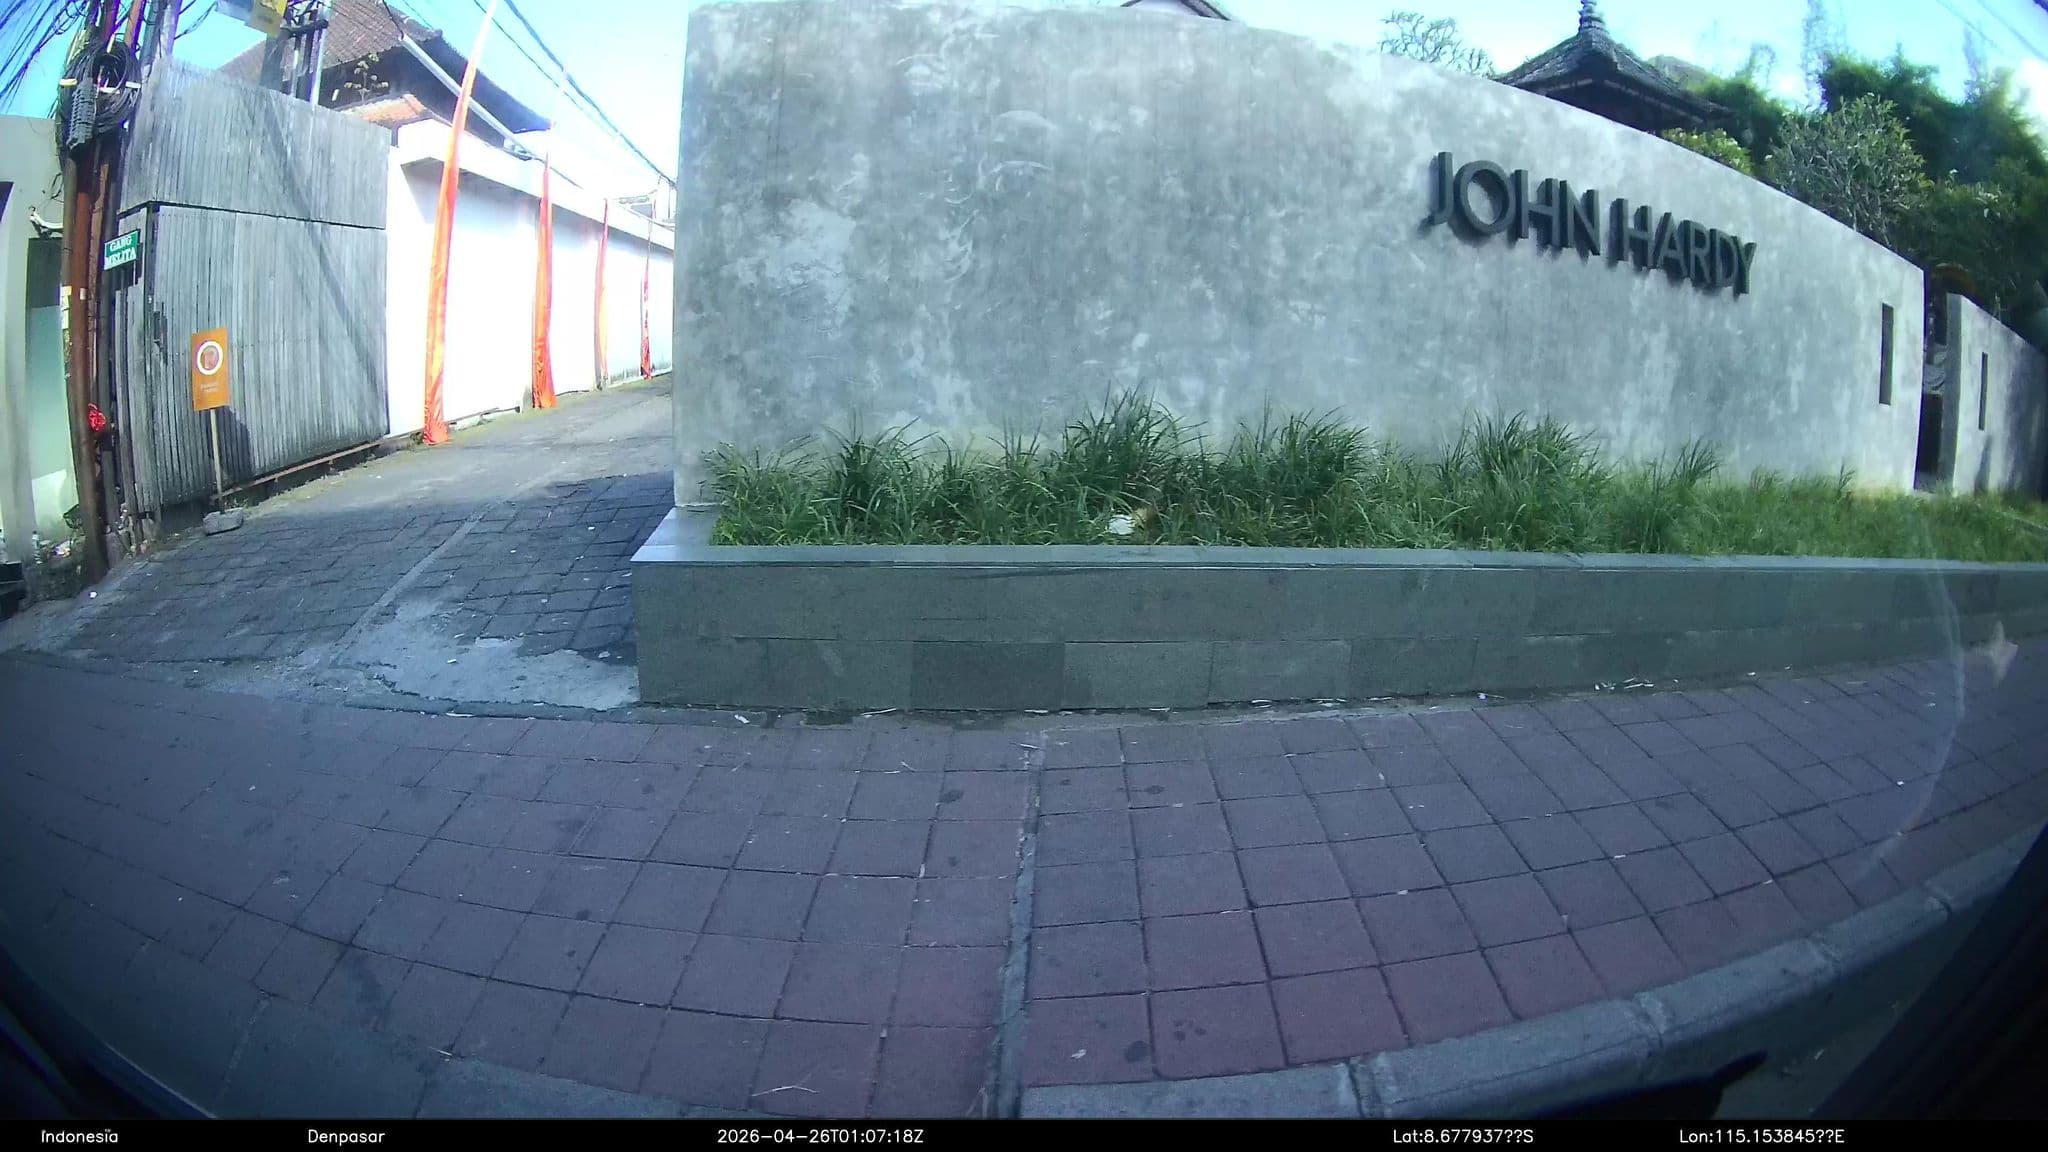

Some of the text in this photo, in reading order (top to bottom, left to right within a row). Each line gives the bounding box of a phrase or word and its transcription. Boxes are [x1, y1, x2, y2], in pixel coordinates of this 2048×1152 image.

[110, 235, 132, 251] GANG
[1425, 151, 1757, 295] JOHN HARDY
